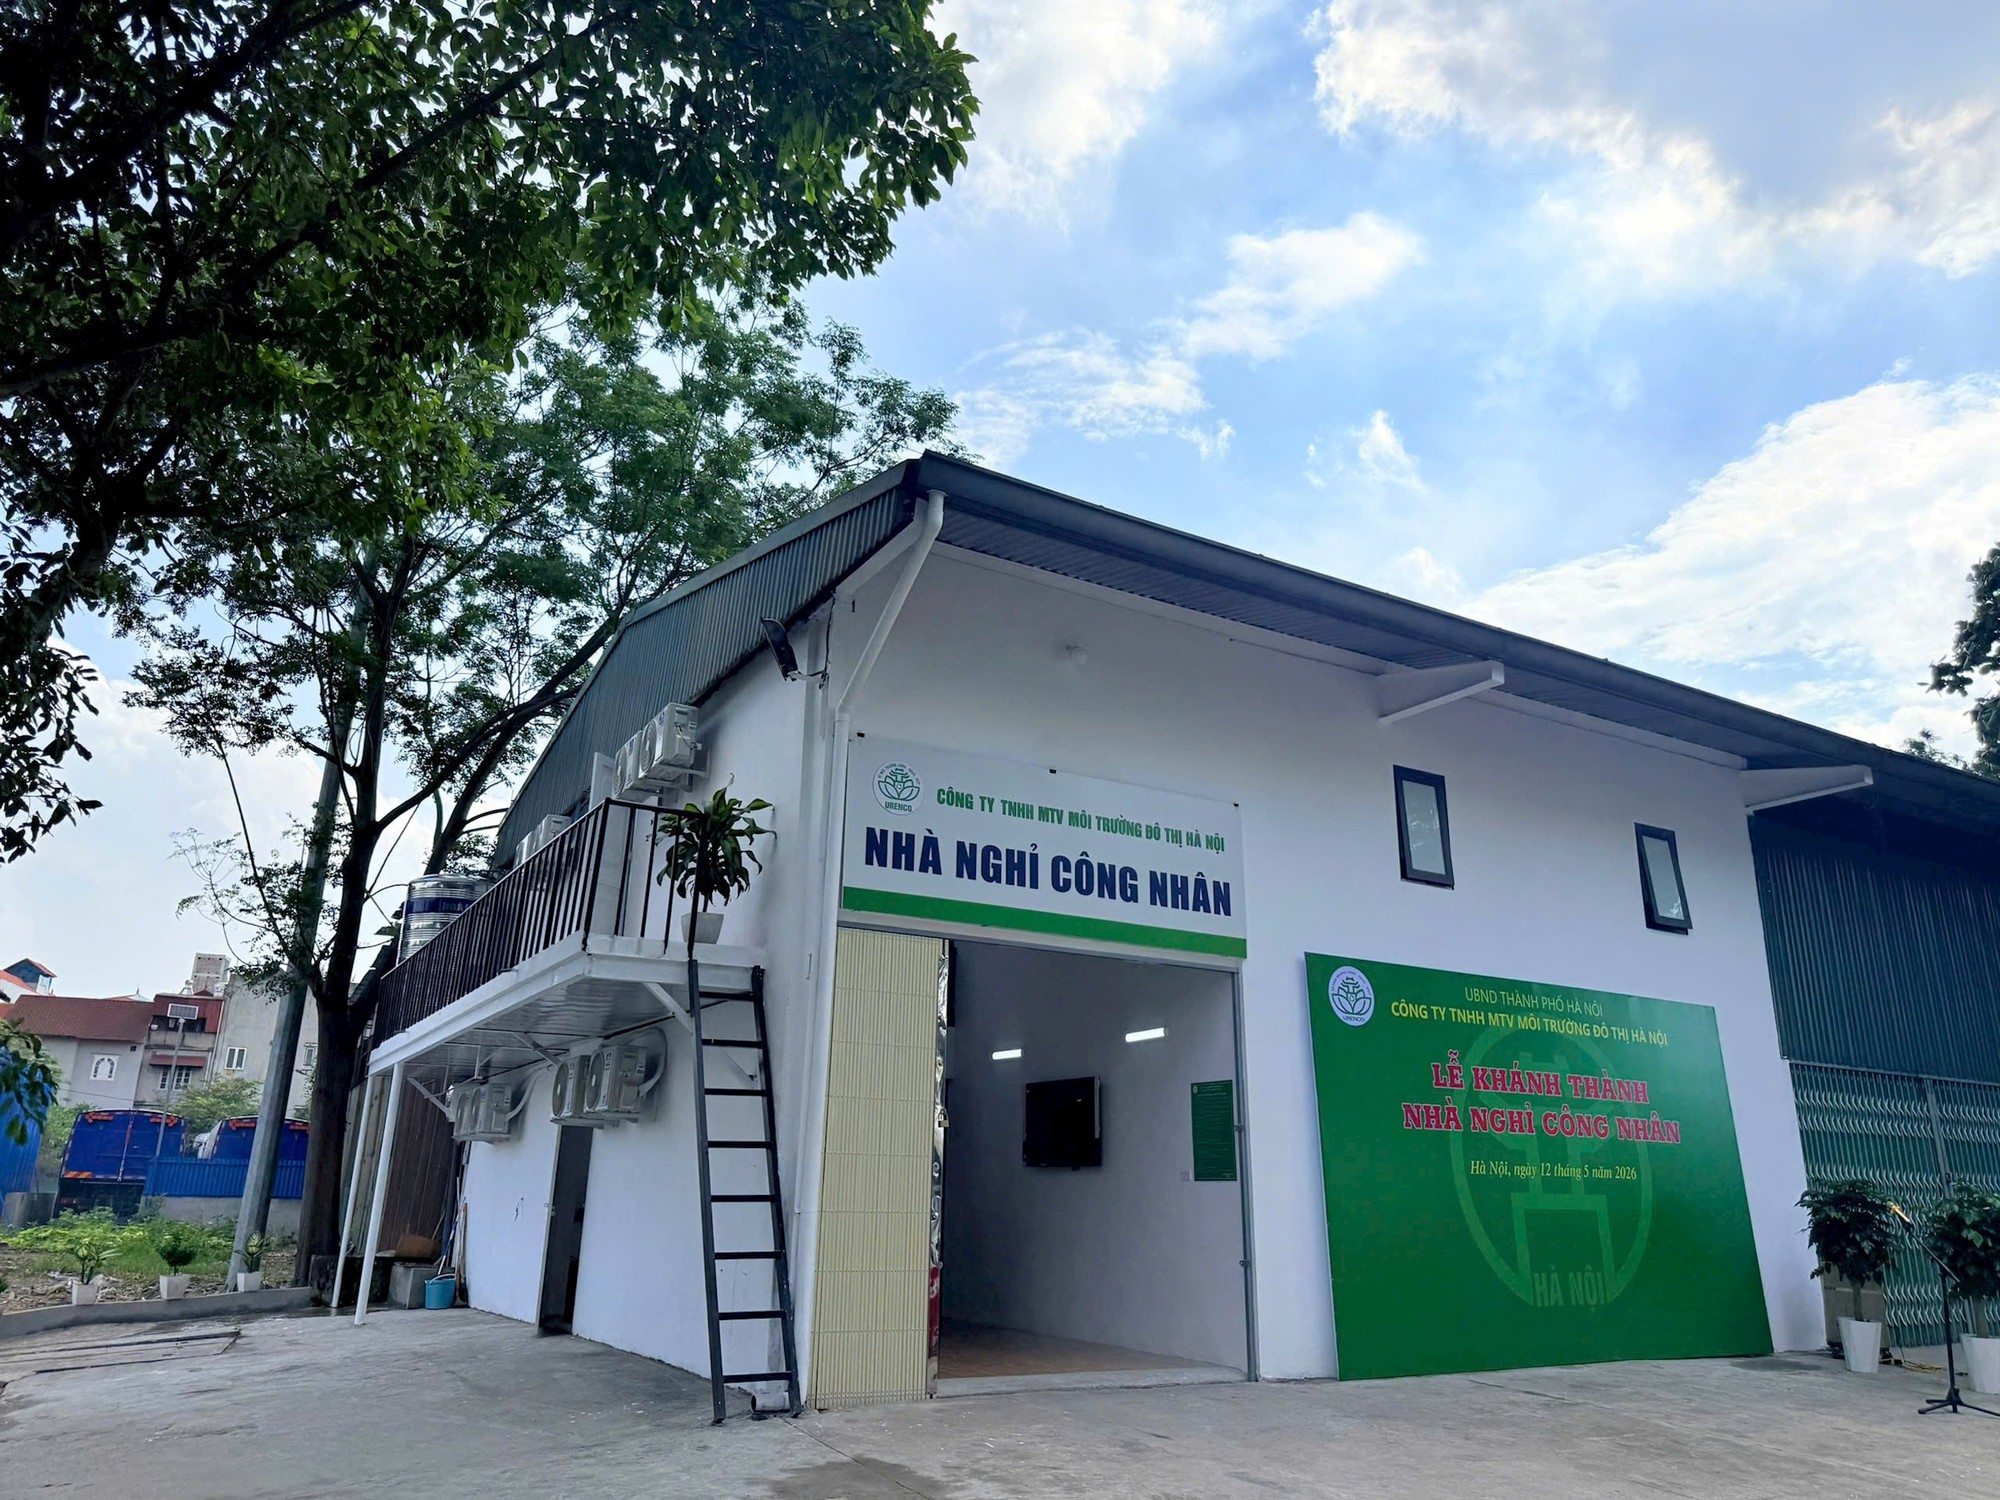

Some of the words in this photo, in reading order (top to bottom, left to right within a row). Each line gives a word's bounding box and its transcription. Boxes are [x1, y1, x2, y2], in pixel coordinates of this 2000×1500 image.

[885, 801, 912, 813] URENCO
[937, 786, 973, 810] CÔNG
[979, 795, 995, 813] TY
[1001, 799, 1034, 820] TNHH
[1038, 805, 1064, 825] MTV
[1068, 810, 1092, 830] MÔI
[1095, 814, 1142, 838] TRƯỜNG
[1145, 822, 1161, 841] ĐÔ
[1164, 827, 1182, 848] THỊ
[1186, 829, 1201, 848] HÀ
[1205, 833, 1225, 854] NỘI
[865, 827, 942, 876] NHÀ
[955, 843, 1039, 889] NGHỈ
[1051, 851, 1139, 903] CÔNG
[1149, 871, 1232, 917] NHÂN
[1391, 999, 1428, 1019] CÔNG
[1431, 1006, 1446, 1021] TY
[1449, 1008, 1485, 1025] TNHH
[1488, 1012, 1514, 1028] MTV
[1517, 1013, 1541, 1031] MÔI
[1543, 1017, 1591, 1036] TRƯỜNG
[1593, 1022, 1609, 1039] ĐÔ
[1611, 1027, 1629, 1044] THỊ
[1631, 1026, 1647, 1043] HÀ
[1650, 1029, 1668, 1048] NỘI
[1465, 987, 1498, 1004] UBND
[1500, 990, 1539, 1008] THÀNH
[1542, 994, 1564, 1012] PHỐ
[1567, 997, 1582, 1013] HÀ
[1584, 1000, 1603, 1019] NỘI
[1431, 1049, 1464, 1089] LỄ
[1471, 1061, 1562, 1097] KHÁNH
[1567, 1069, 1650, 1104] THÀNH
[1402, 1096, 1463, 1131] NHÀ
[1469, 1102, 1536, 1135] NGHỈ
[1542, 1104, 1610, 1139] CÔNG
[1616, 1111, 1681, 1144] NHÂN
[1470, 1160, 1486, 1175] Hà
[1489, 1161, 1511, 1178] Nội,
[1514, 1163, 1537, 1179] ngày
[1540, 1162, 1550, 1176] 12
[1554, 1163, 1581, 1180] tháng
[1583, 1164, 1589, 1178] 5
[1592, 1165, 1612, 1179] năm
[1615, 1166, 1637, 1180] 2026
[1533, 1265, 1564, 1307] HÀ
[1568, 1264, 1607, 1313] NỘI
